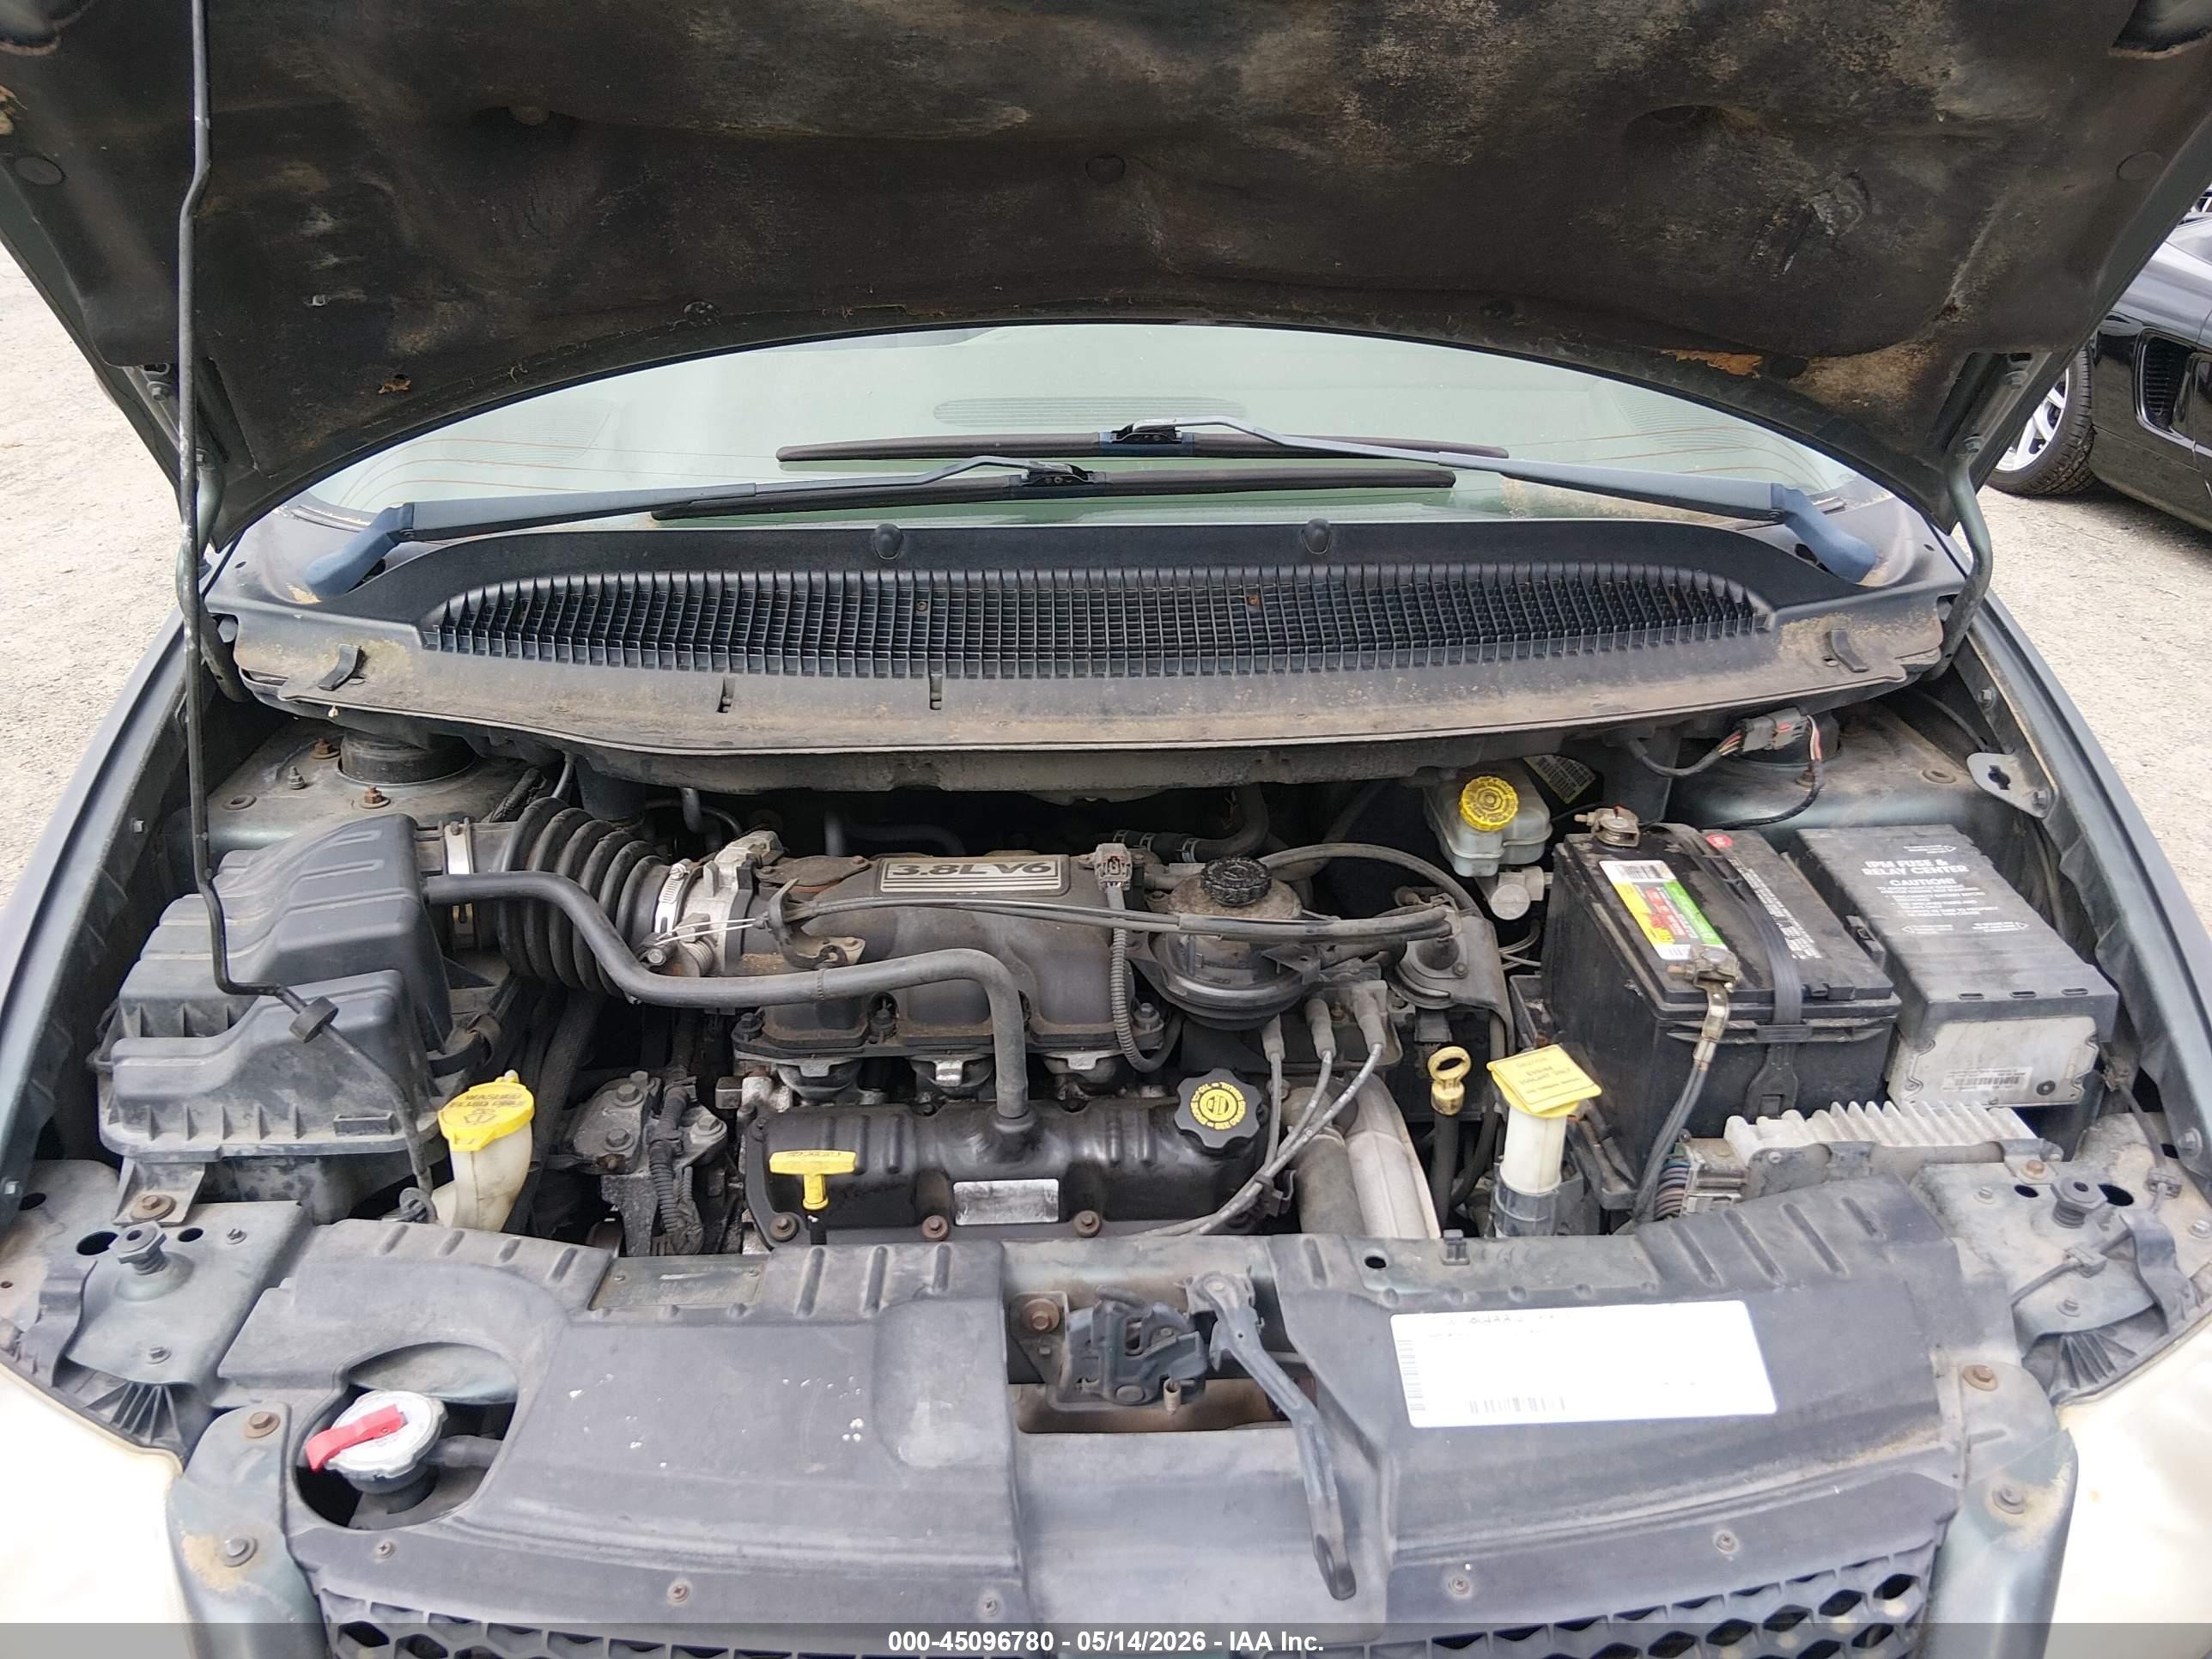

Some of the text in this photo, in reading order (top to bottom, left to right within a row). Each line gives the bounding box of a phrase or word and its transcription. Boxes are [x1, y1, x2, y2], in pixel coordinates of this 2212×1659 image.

[892, 862, 1052, 876] 3.8L V6
[1861, 866, 1970, 876] RELAY CENTER
